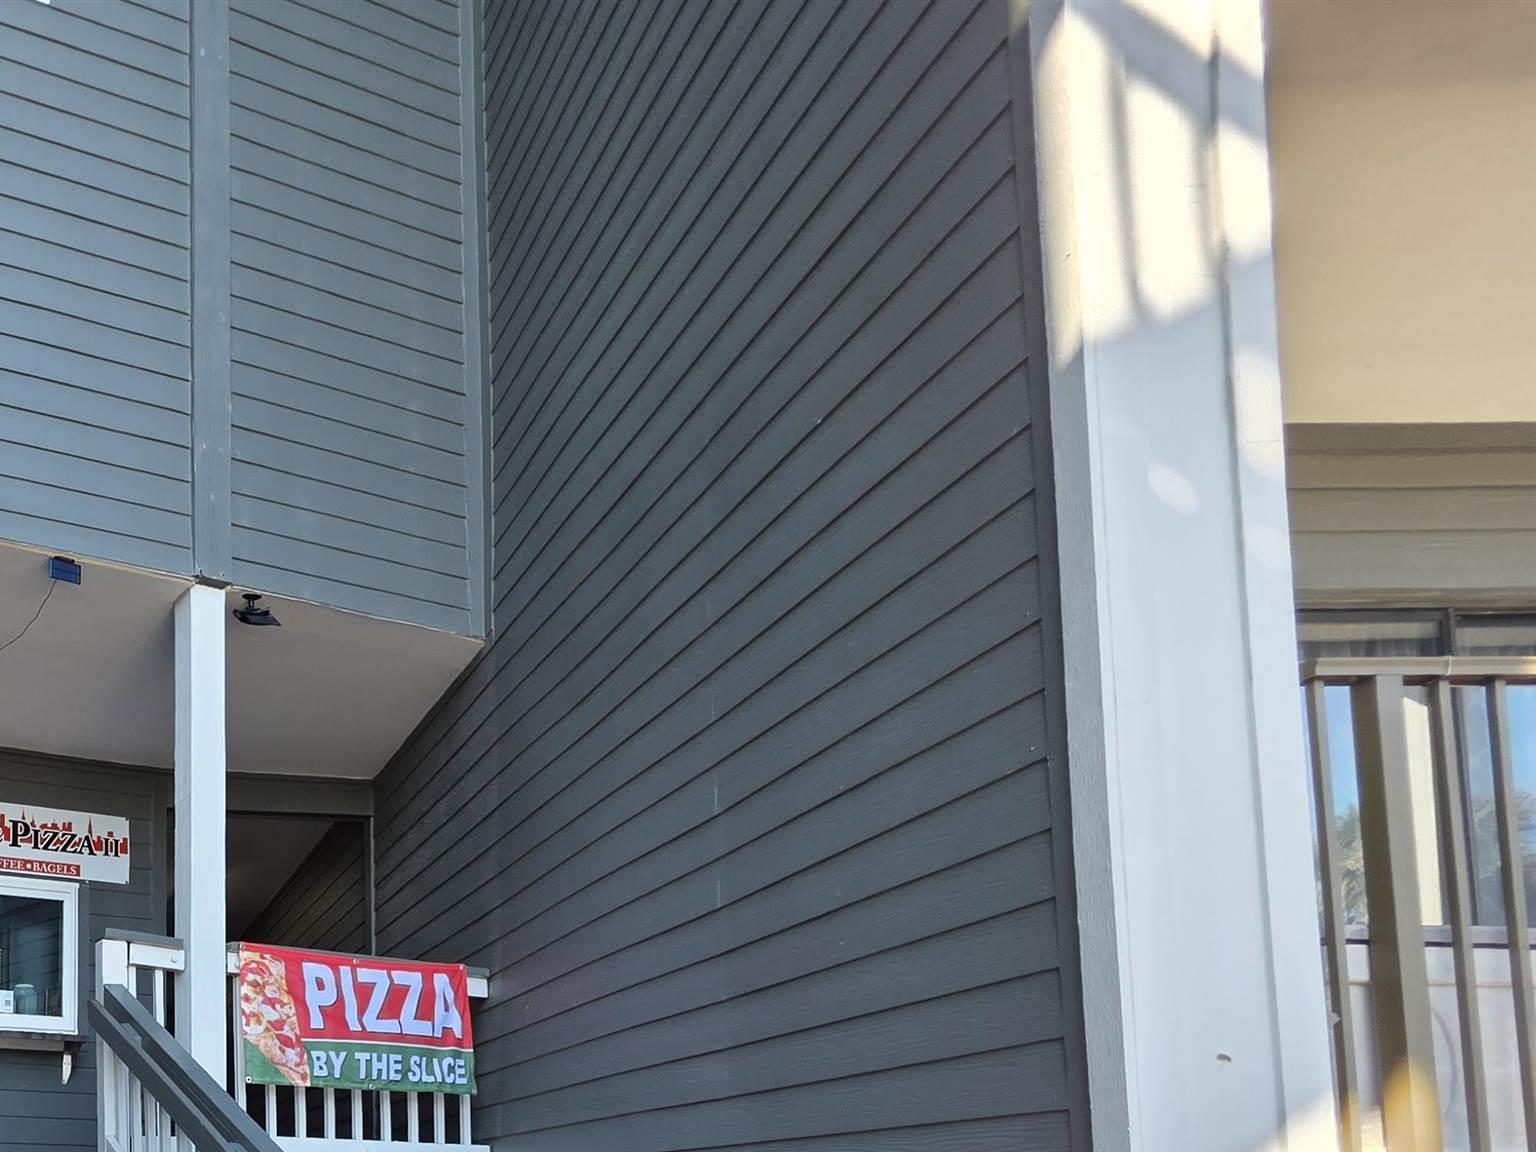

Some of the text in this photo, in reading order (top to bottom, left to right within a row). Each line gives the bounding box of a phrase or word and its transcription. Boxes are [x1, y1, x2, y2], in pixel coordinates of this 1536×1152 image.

[102, 836, 121, 858] II
[33, 862, 77, 876] BAGELS
[302, 961, 463, 1039] PIZZA
[311, 1050, 468, 1085] BY THE SLICE
